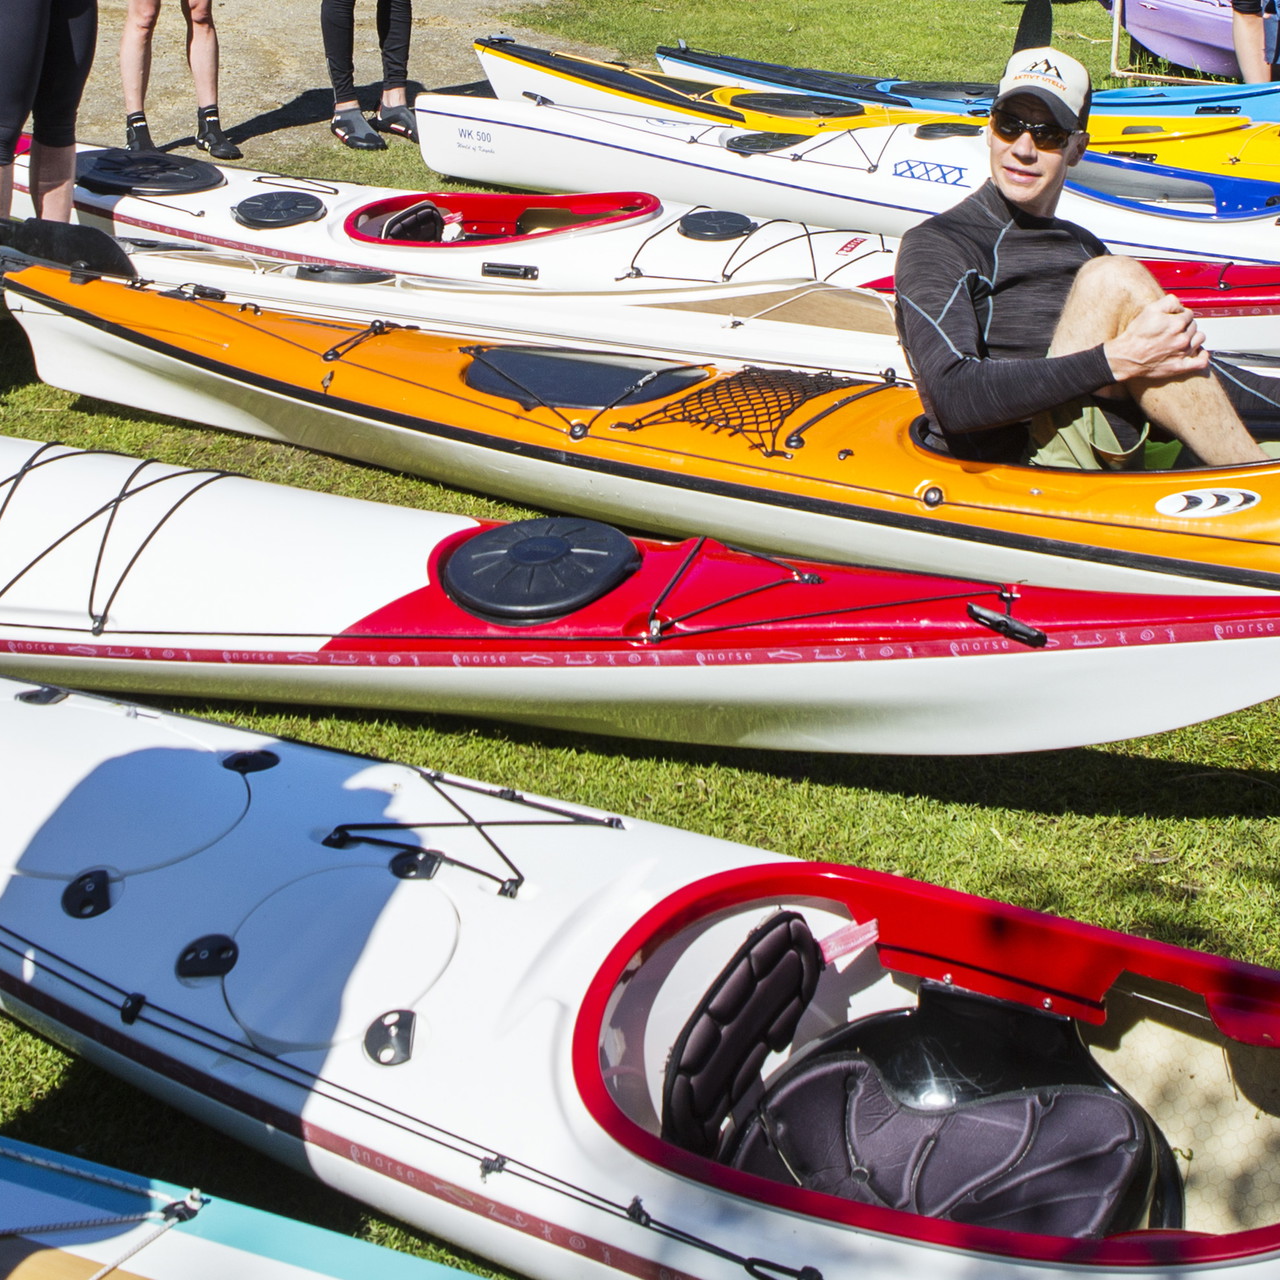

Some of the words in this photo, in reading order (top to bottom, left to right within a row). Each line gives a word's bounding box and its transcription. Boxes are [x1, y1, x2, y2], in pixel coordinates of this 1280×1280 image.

[458, 128, 475, 140] WK
[476, 131, 492, 143] 500
[1224, 620, 1276, 635] norse
[16, 640, 56, 653] norse
[960, 639, 1010, 653] norse
[231, 650, 276, 663] norse
[461, 654, 508, 666] norse
[707, 650, 754, 663] norse
[362, 1150, 416, 1181] norse
